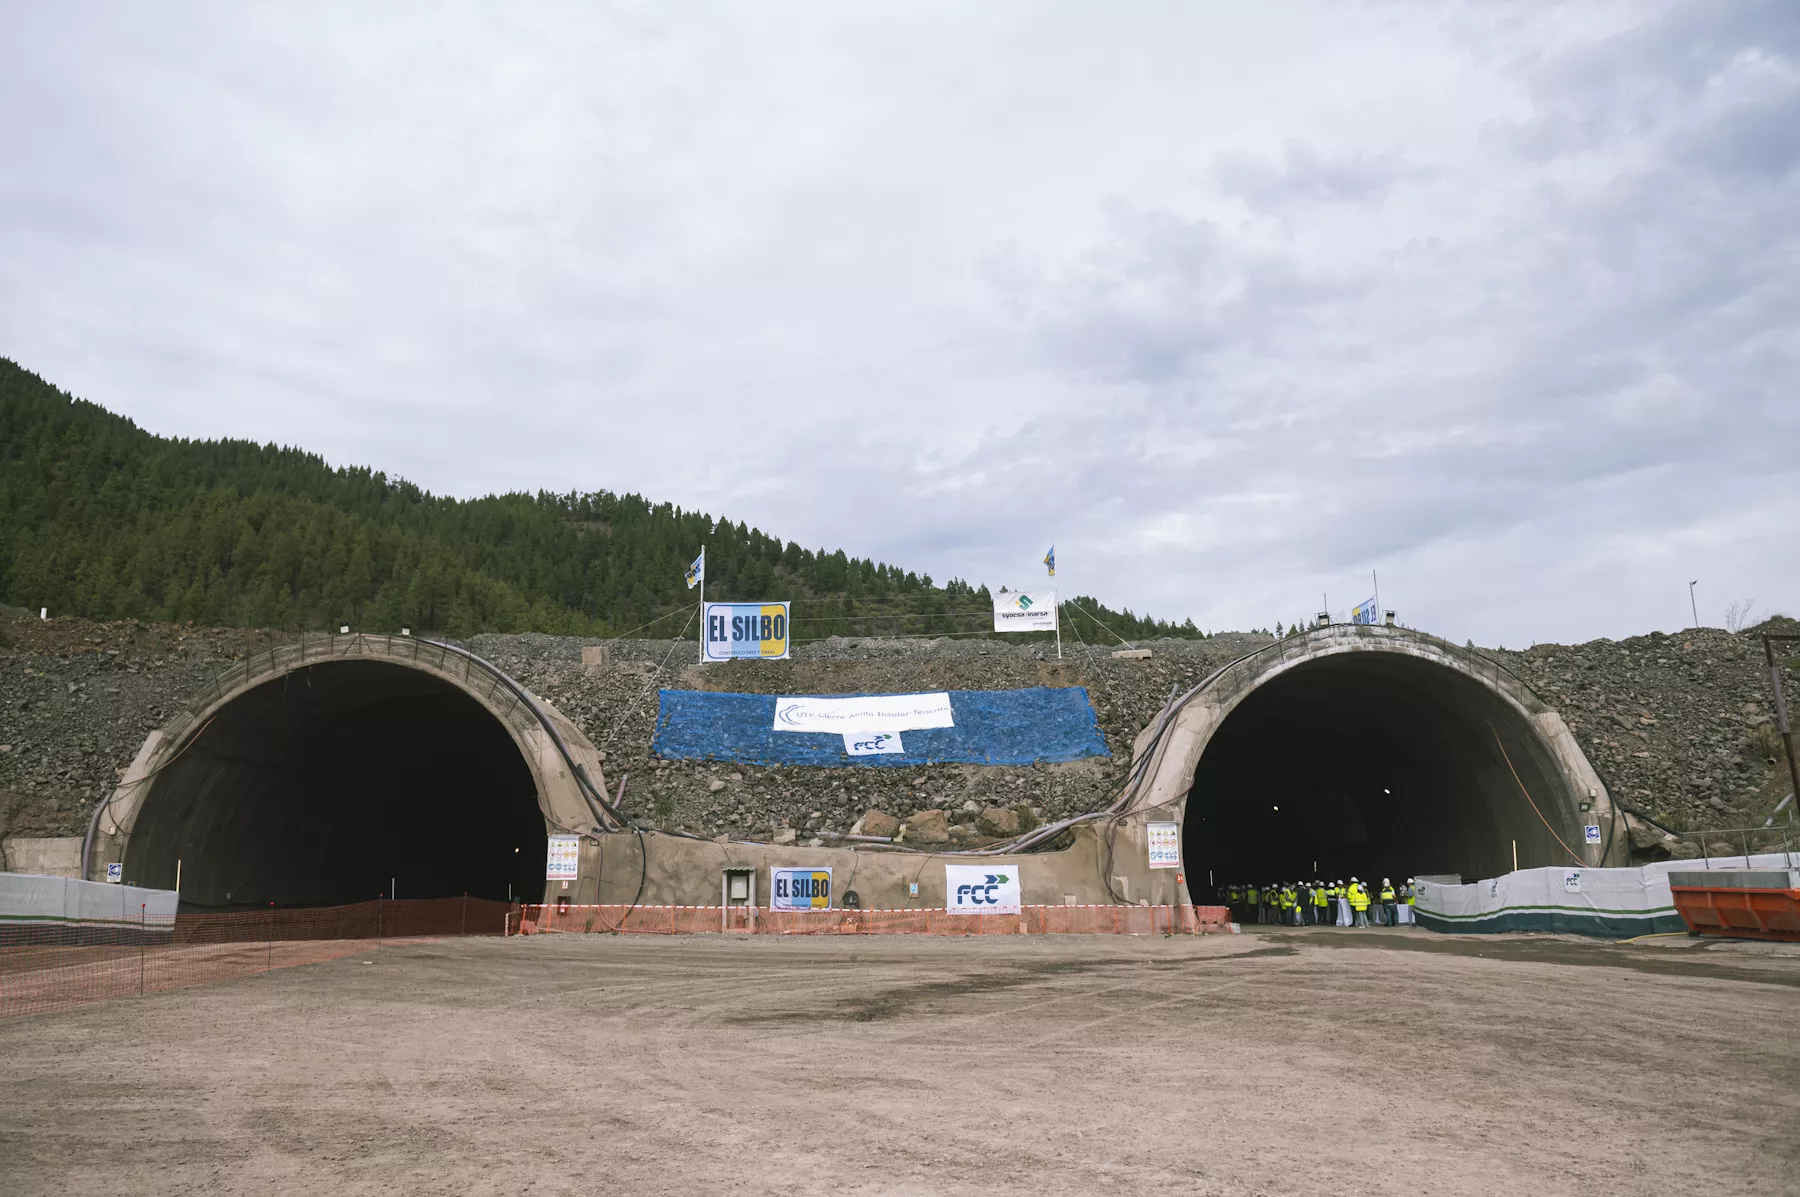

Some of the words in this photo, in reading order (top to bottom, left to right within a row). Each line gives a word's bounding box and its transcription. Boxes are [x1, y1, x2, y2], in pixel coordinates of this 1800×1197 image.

[709, 615, 727, 642] EL
[732, 614, 785, 642] SILBO
[854, 739, 886, 751] FCC
[776, 879, 789, 898] EL
[792, 879, 829, 898] SILBO
[957, 885, 999, 905] FCC
